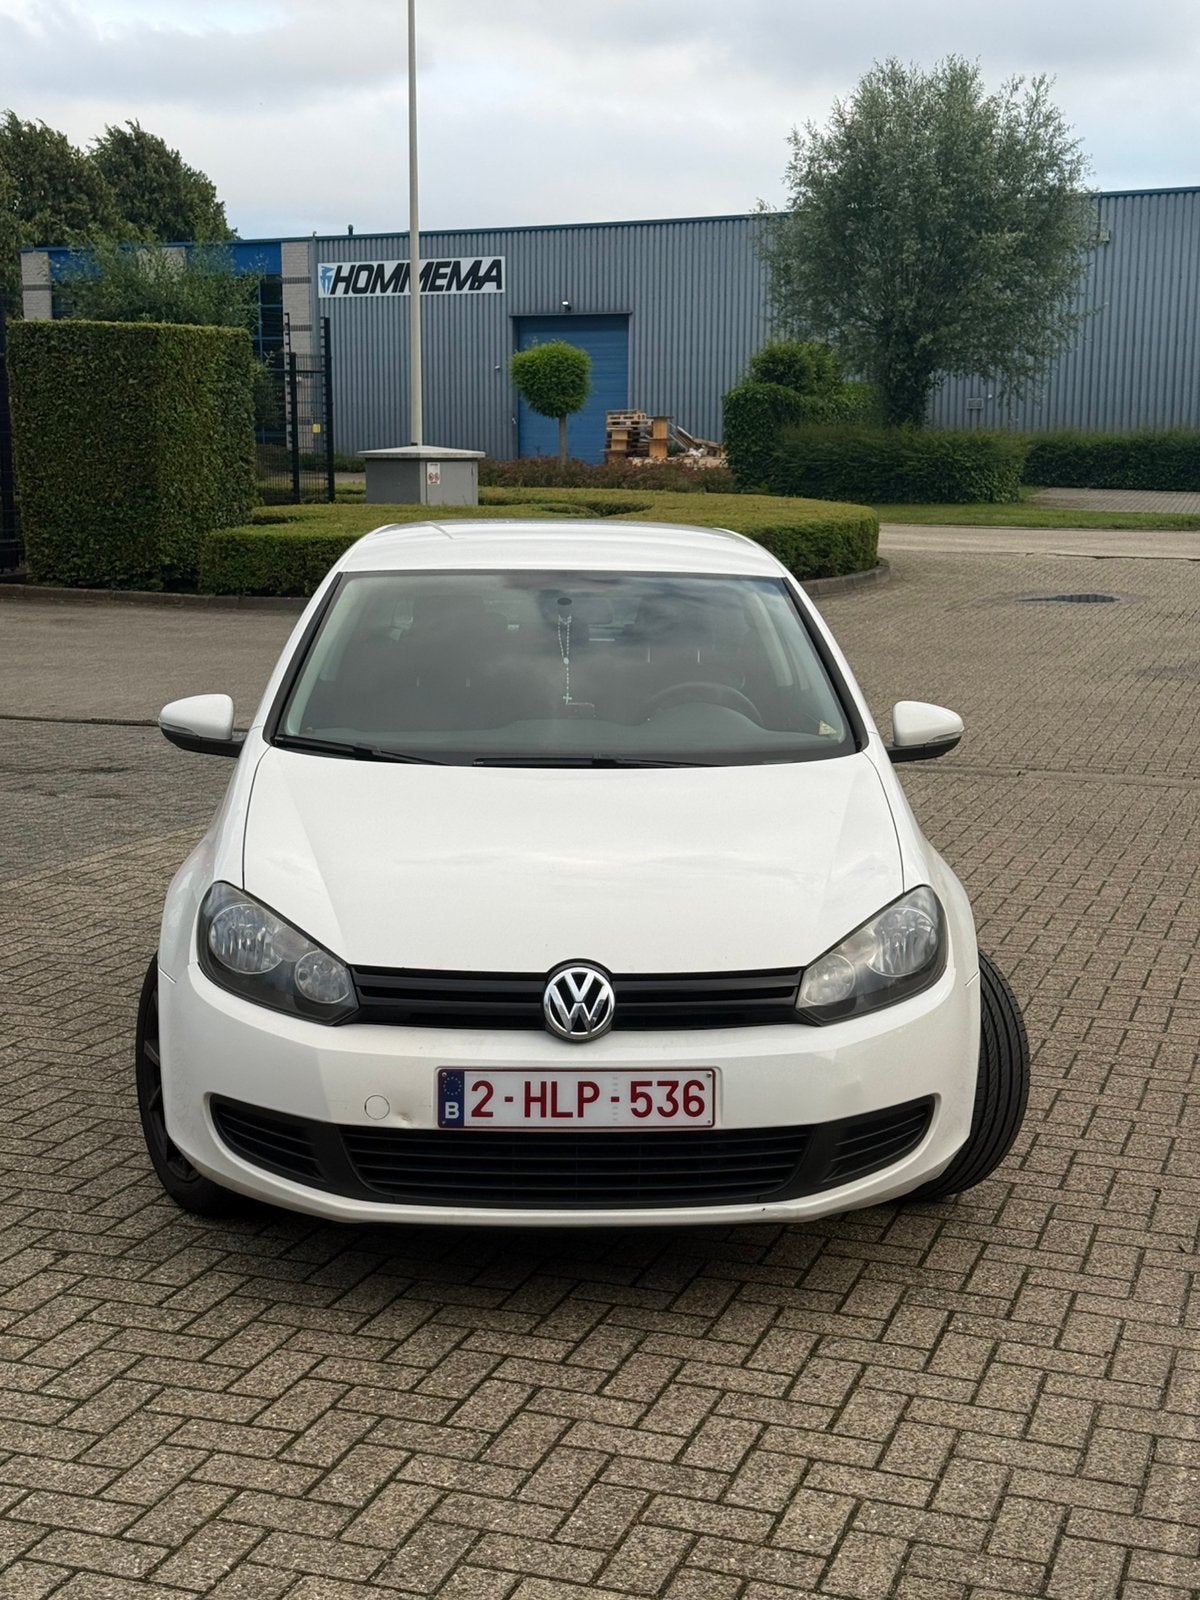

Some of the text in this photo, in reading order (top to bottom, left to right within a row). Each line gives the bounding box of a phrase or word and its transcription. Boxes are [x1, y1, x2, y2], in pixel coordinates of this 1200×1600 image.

[330, 259, 502, 295] HOMMEMA
[444, 1101, 460, 1119] B
[470, 1079, 706, 1119] 2-HLP-536
